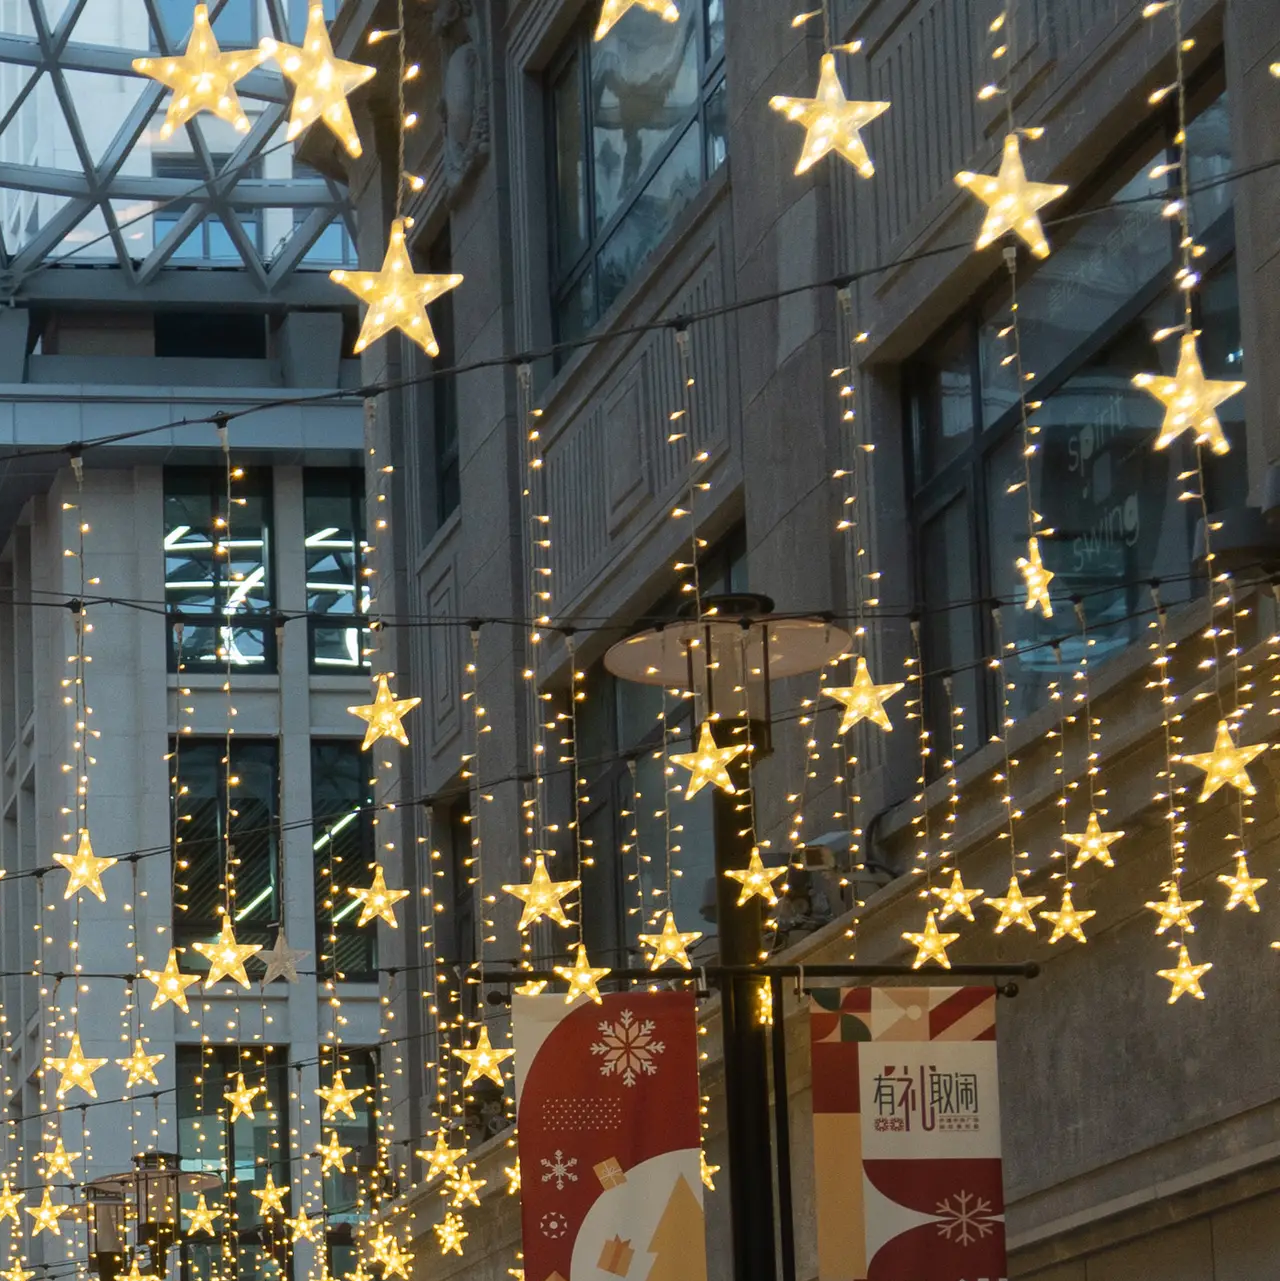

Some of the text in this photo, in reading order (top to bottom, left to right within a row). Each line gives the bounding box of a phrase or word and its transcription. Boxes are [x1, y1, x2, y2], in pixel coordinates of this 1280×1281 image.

[1068, 392, 1125, 477] spirit
[1073, 491, 1140, 572] swing
[873, 1065, 979, 1132] 有礼取闹
